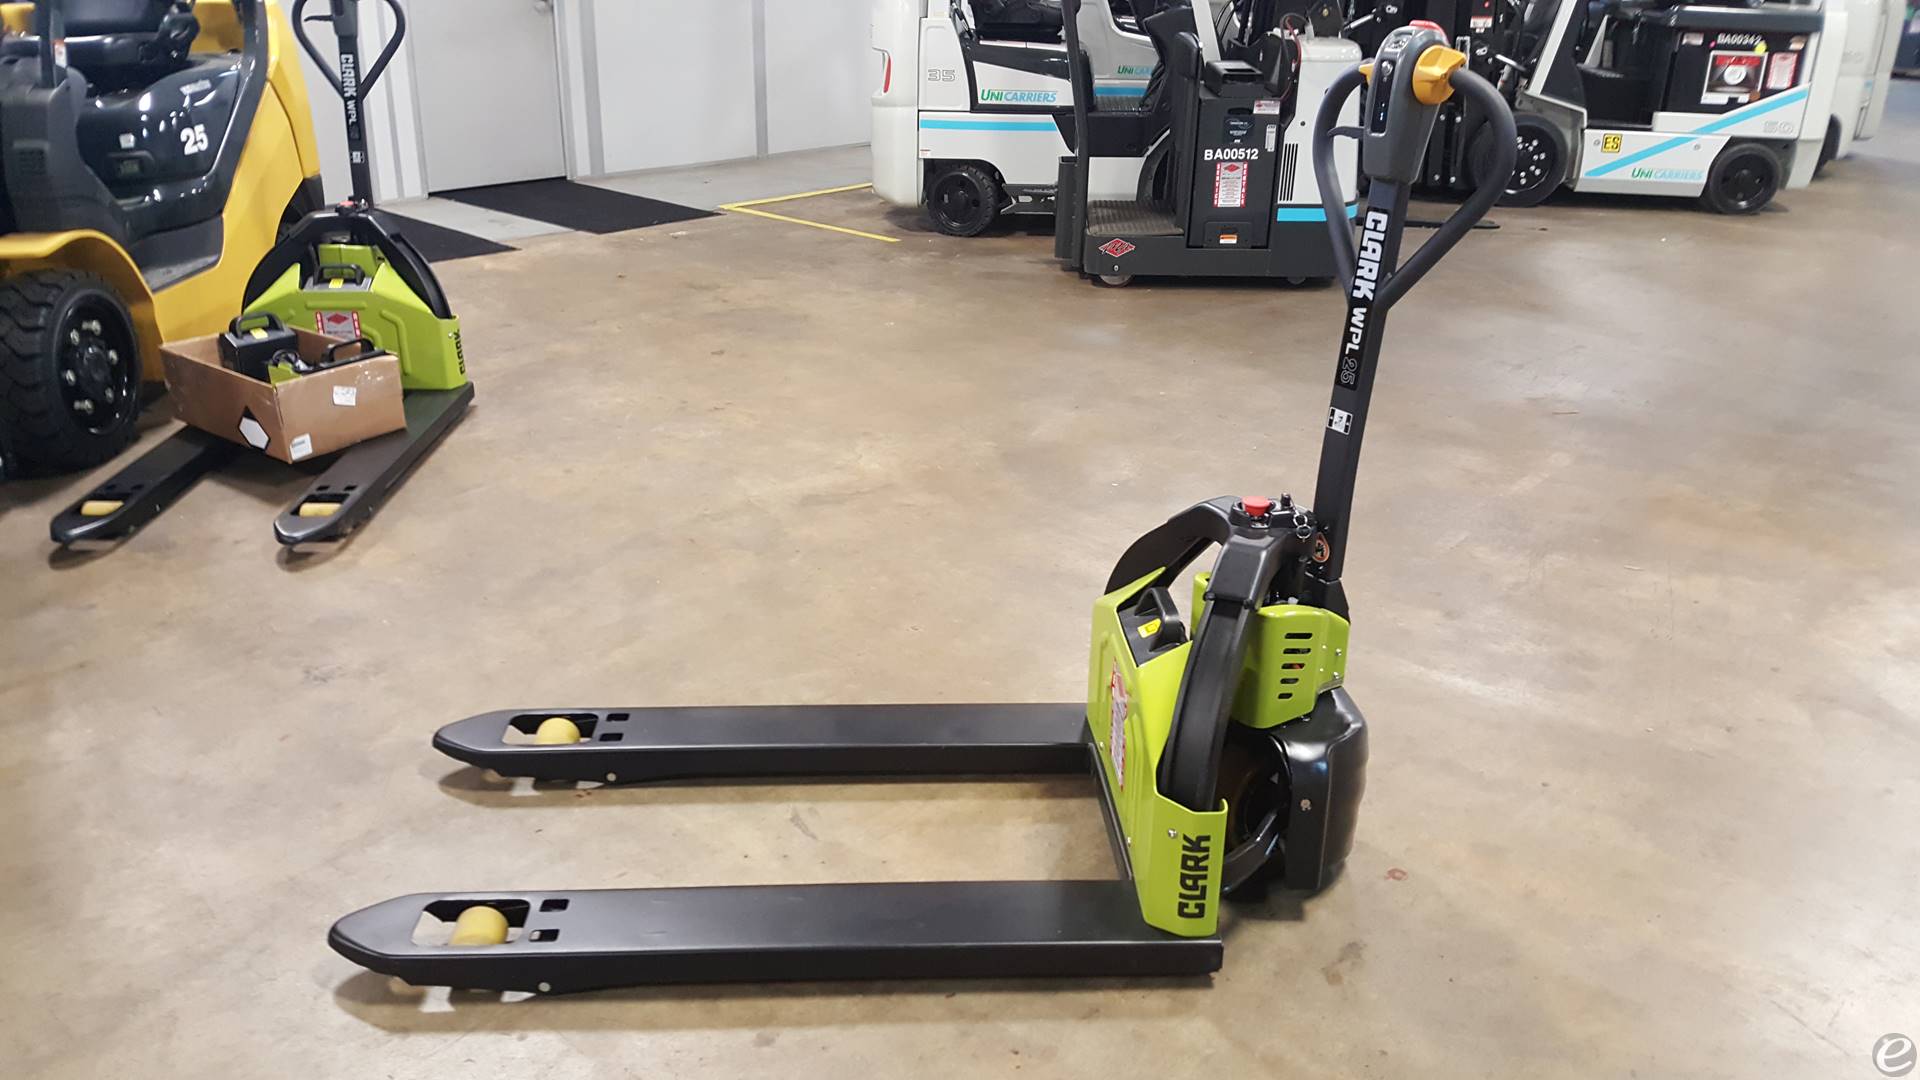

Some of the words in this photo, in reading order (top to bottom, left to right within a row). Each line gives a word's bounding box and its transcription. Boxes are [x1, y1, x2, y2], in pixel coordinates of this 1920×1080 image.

[341, 54, 357, 97] CLARK
[928, 69, 956, 81] 35
[347, 100, 357, 125] WPL
[180, 124, 208, 156] 25
[1204, 148, 1259, 161] BA00512
[1603, 136, 1620, 150] ES
[1352, 210, 1388, 302] CLARK
[1345, 307, 1367, 355] WPL
[1340, 356, 1358, 385] 25
[1177, 833, 1212, 920] CLARK
